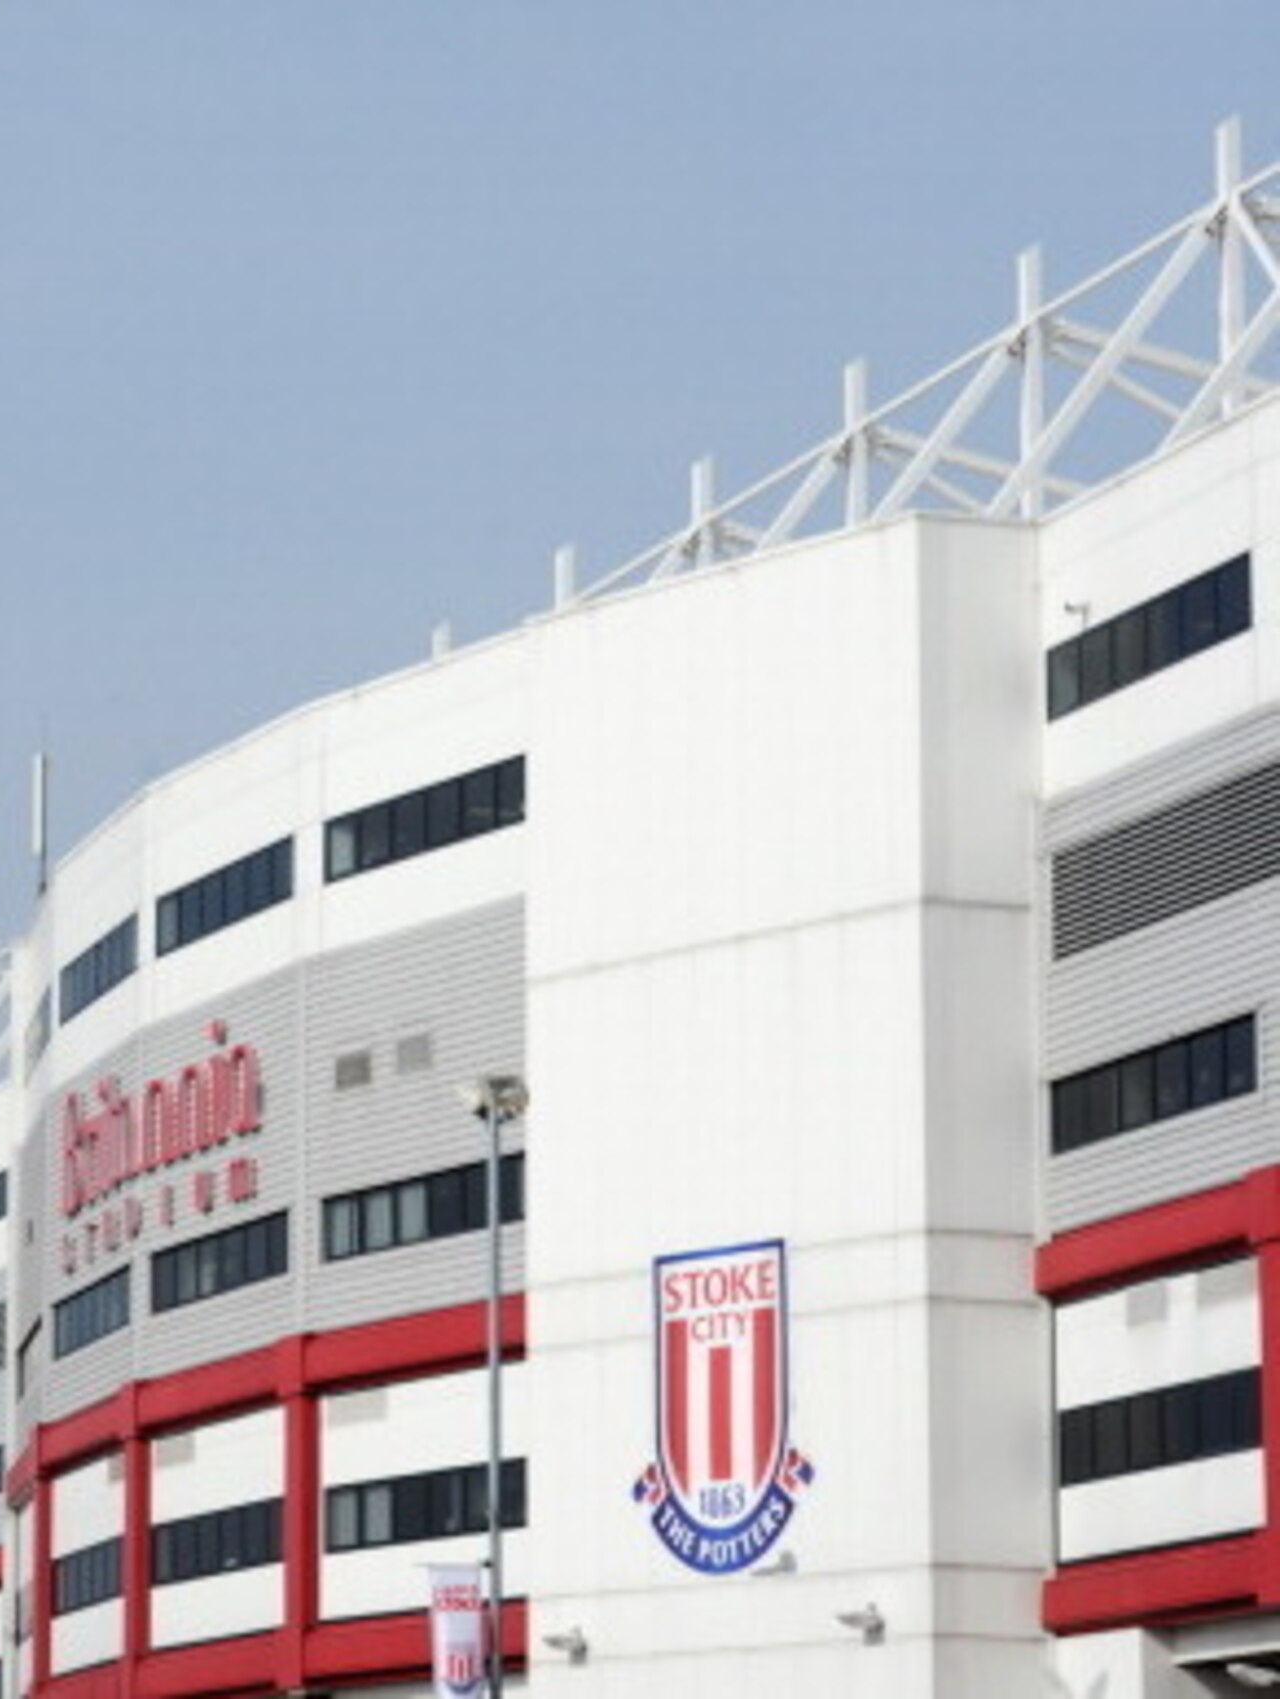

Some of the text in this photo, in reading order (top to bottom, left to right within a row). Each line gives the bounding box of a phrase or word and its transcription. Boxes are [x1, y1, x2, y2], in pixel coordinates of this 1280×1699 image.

[665, 1260, 775, 1314] STOKE
[690, 1310, 748, 1342] CITY
[699, 1484, 746, 1519] 1863
[661, 1497, 784, 1567] THE POTTERS
